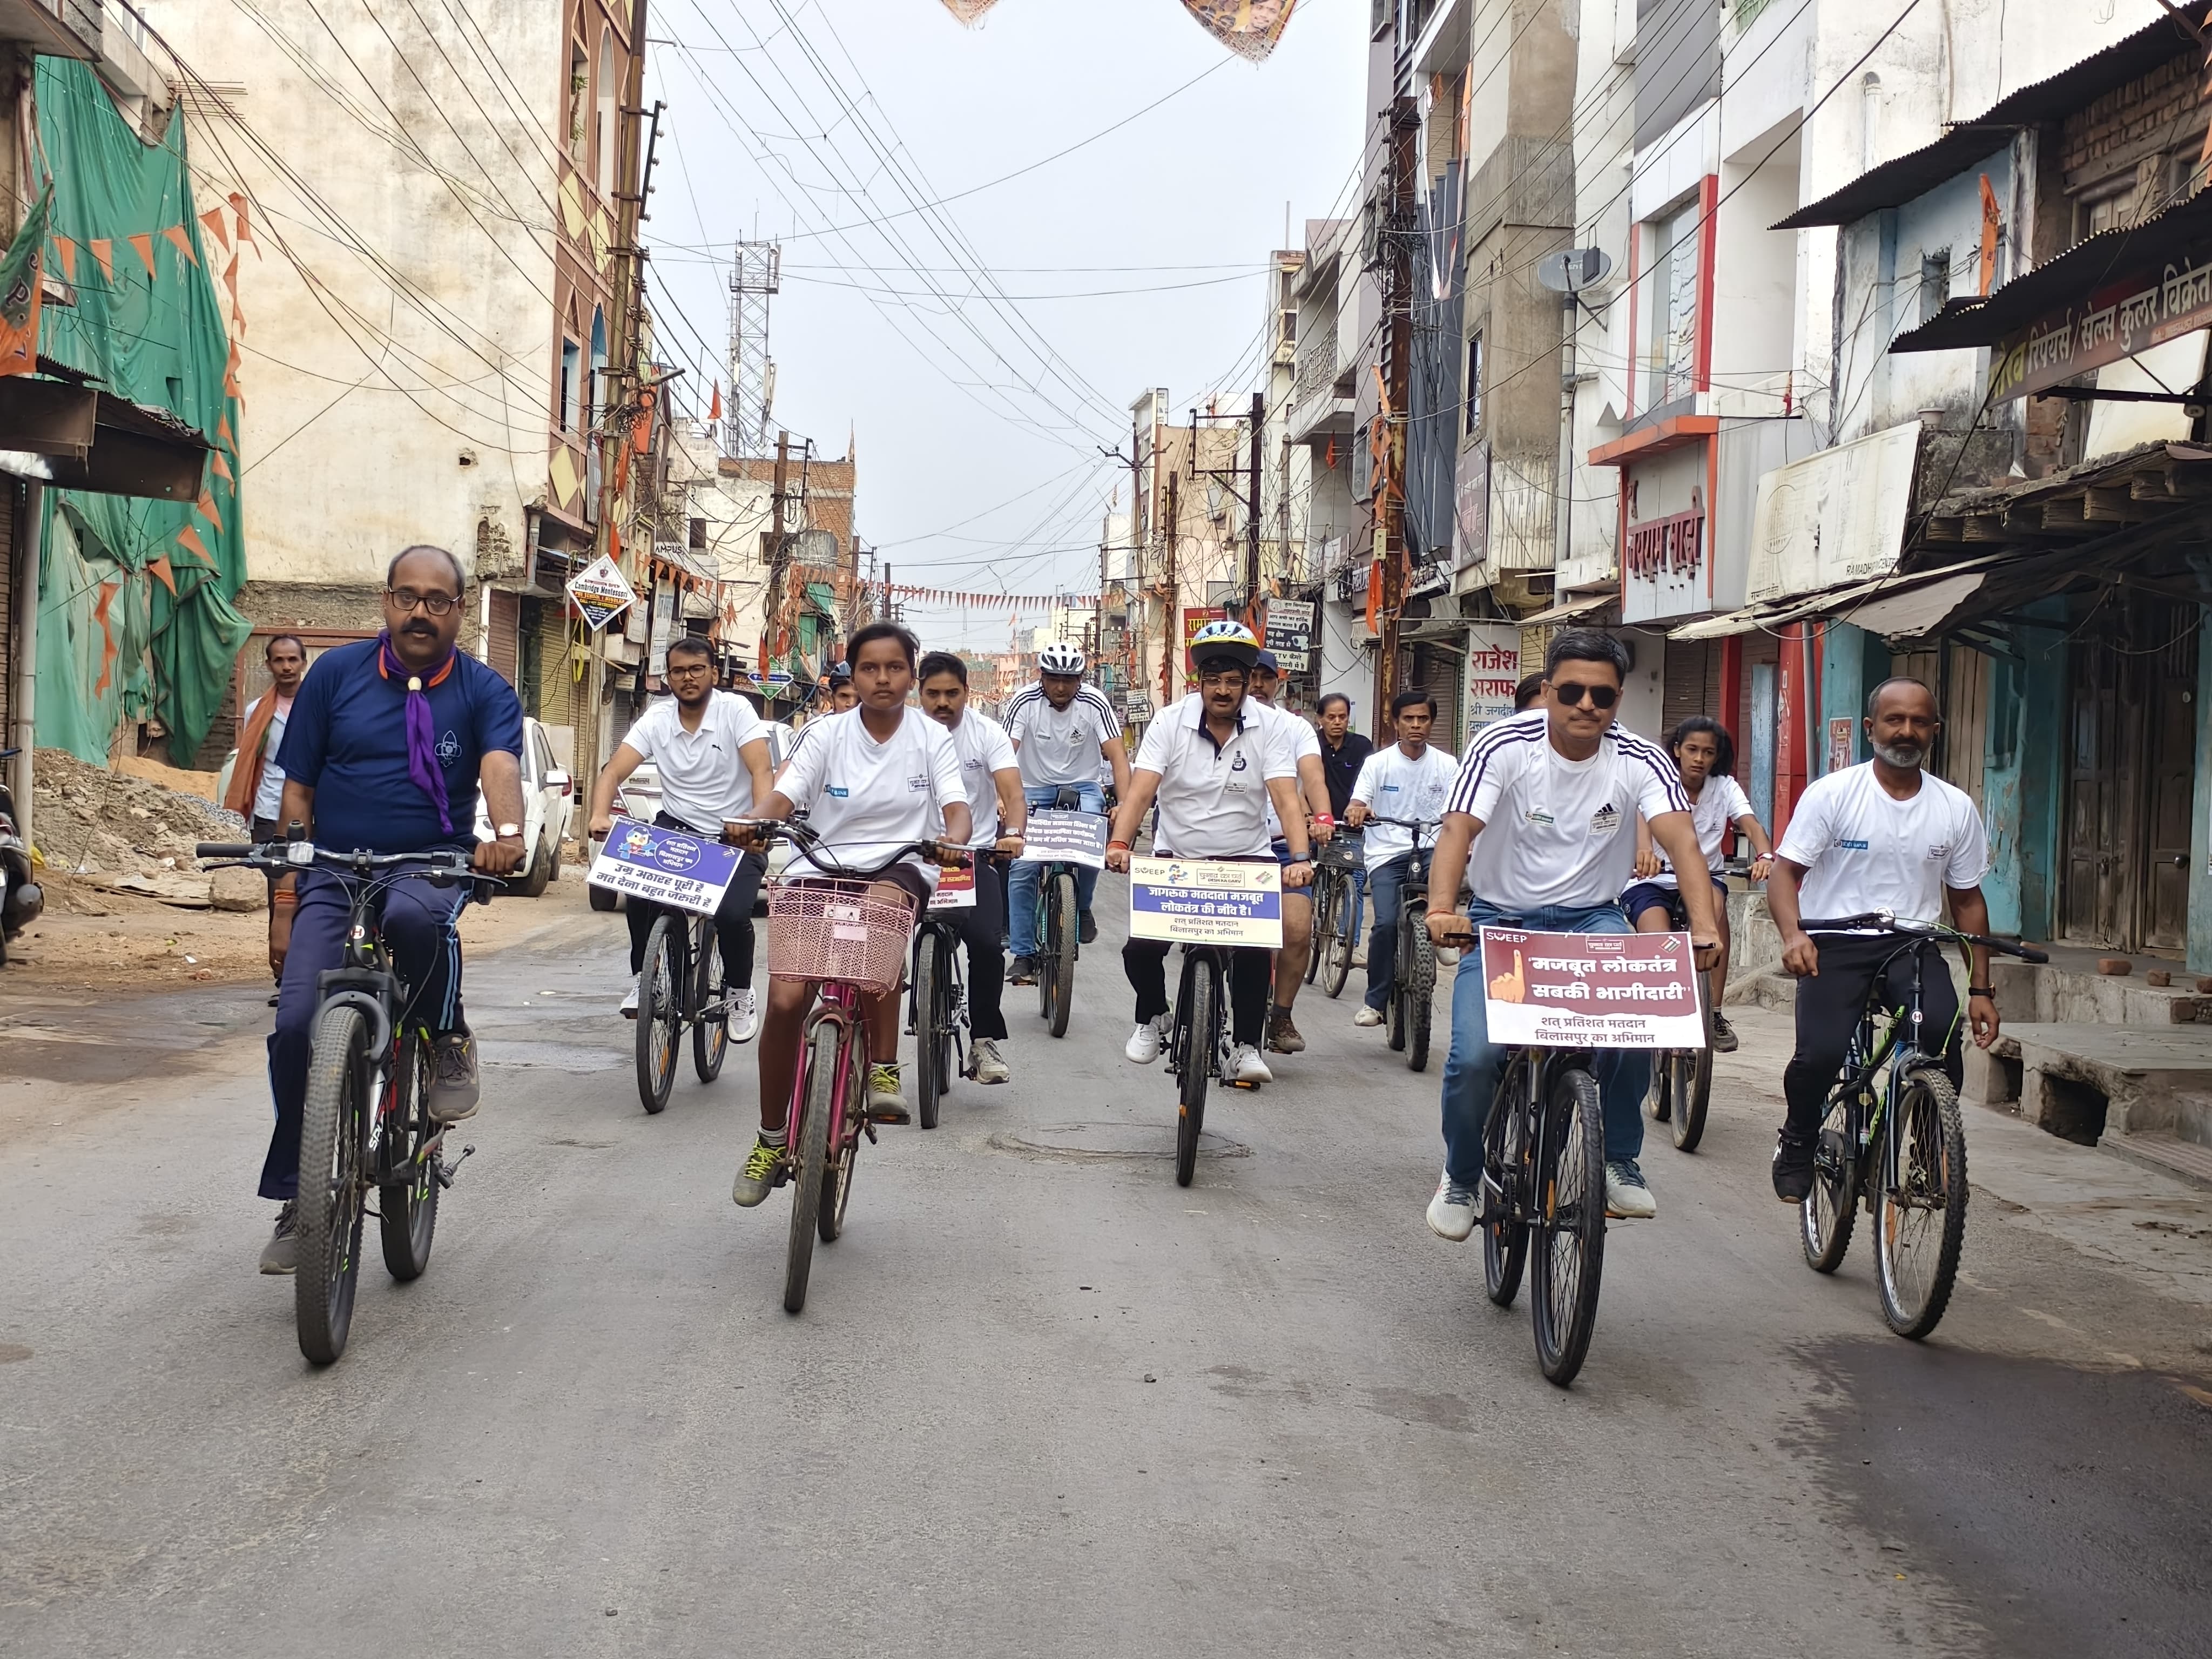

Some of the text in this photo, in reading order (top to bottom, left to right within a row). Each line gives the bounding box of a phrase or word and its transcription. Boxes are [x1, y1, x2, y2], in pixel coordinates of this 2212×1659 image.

[2120, 287, 2158, 352] कुलर
[2162, 257, 2212, 320] विक्रेत
[575, 582, 599, 594] Cambridge
[601, 586, 628, 598] Montessori
[1472, 644, 1519, 671] राजेश
[1471, 702, 1482, 715] श्री
[615, 864, 704, 893] उम्र अठारह पूरी है
[597, 872, 617, 884] मत
[618, 876, 640, 890] देना
[642, 884, 667, 897] बहुत
[703, 897, 712, 907] है
[1190, 890, 1229, 900] मतदाता
[1230, 892, 1264, 905] मजबूत
[1160, 900, 1199, 913] लोकतंत्र
[1201, 902, 1215, 914] की
[1216, 903, 1238, 915] नींव
[1188, 918, 1213, 926] प्रतिशत
[1170, 925, 1202, 936] बिलासपुर
[1217, 928, 1244, 936] अभिमान
[1601, 955, 1677, 973] लोकतंत्र
[1531, 981, 1590, 999] सबकी
[1541, 1016, 1645, 1030] शत् प्रतिशत मतदान
[1535, 1029, 1655, 1044] बिलासपुर का अभिमान
